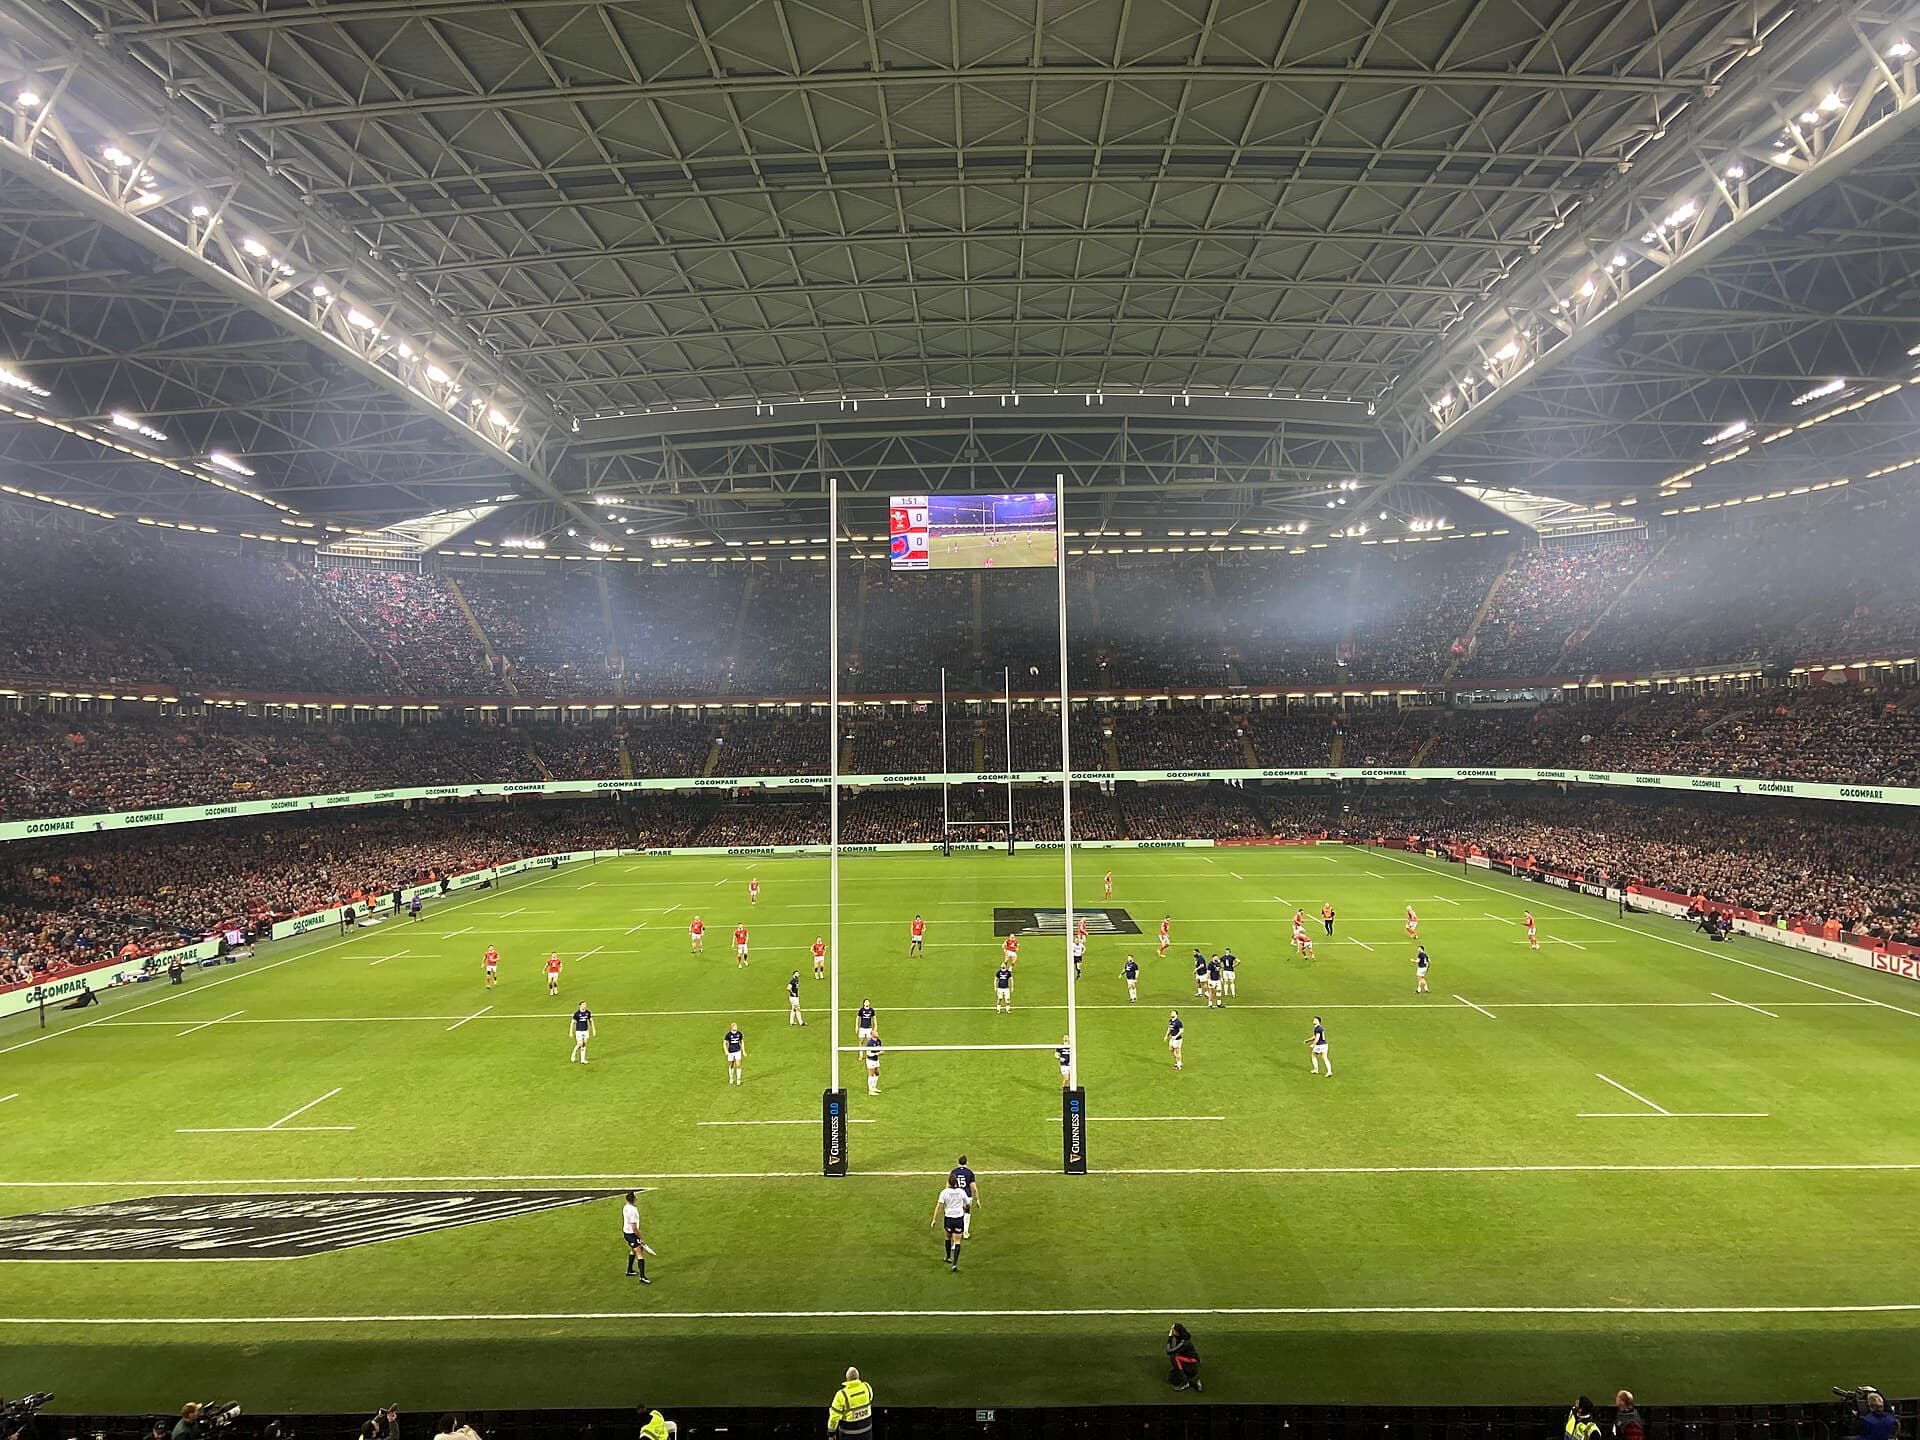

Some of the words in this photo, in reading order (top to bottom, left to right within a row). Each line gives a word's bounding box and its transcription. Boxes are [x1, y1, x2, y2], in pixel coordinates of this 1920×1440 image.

[916, 513, 922, 522] 0
[917, 537, 923, 546] 0
[830, 1115, 839, 1156] GUINNESS
[1071, 1113, 1080, 1153] GUINNESS
[957, 1177, 967, 1188] 15
